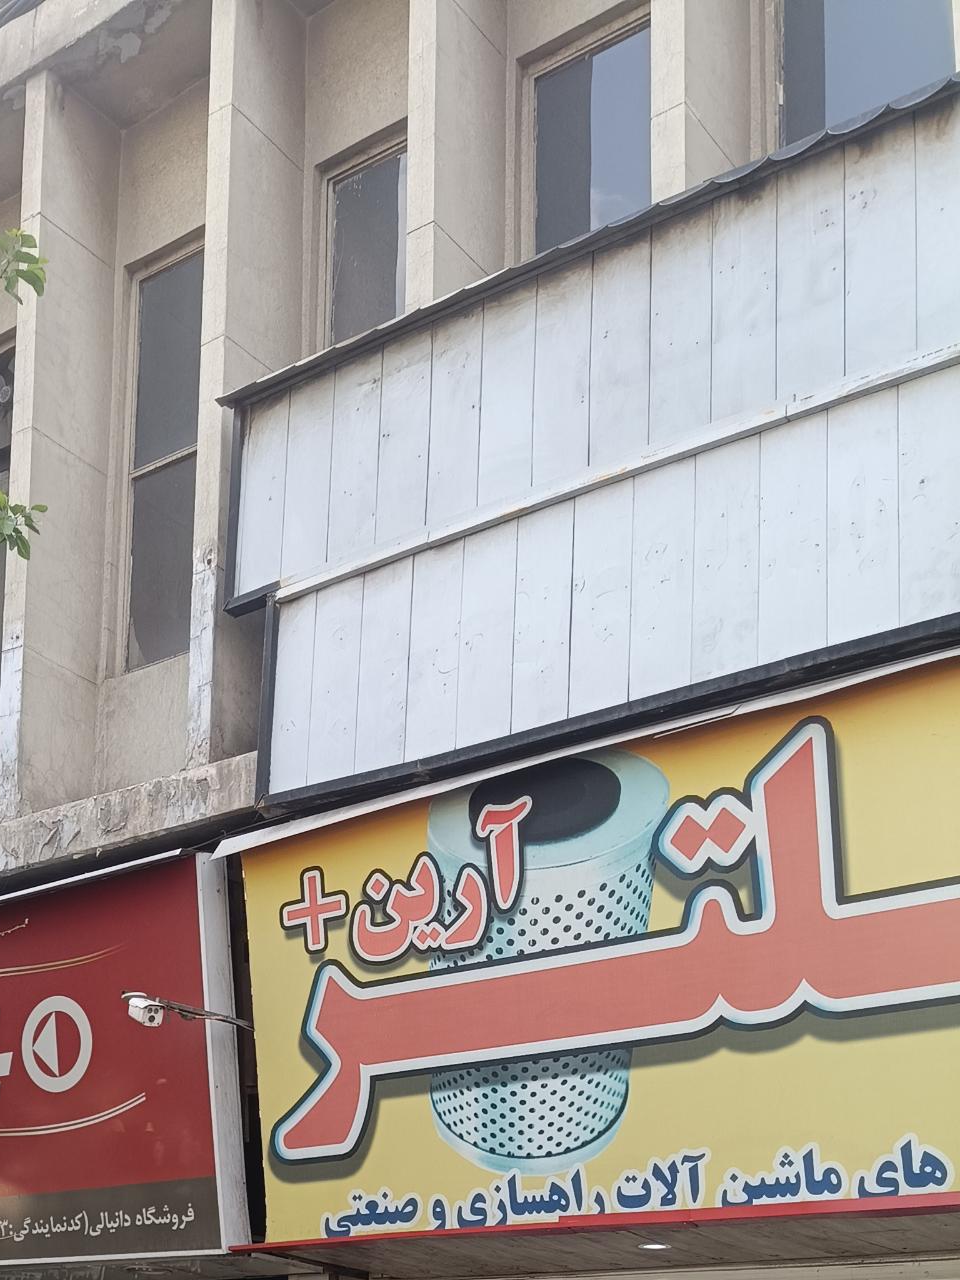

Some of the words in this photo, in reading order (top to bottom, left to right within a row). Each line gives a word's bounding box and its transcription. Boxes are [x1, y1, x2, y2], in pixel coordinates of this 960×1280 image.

[351, 797, 531, 963] آرین
[276, 720, 960, 1157] لتر
[616, 1153, 707, 1214] آلات
[722, 1149, 842, 1206] ماشین
[859, 1138, 949, 1197] های
[89, 1209, 131, 1237] دانیالی
[135, 1202, 195, 1230] فروشگاه
[323, 1191, 416, 1238] صنعتی
[431, 1201, 445, 1230] و
[456, 1168, 605, 1230] راهسازی
